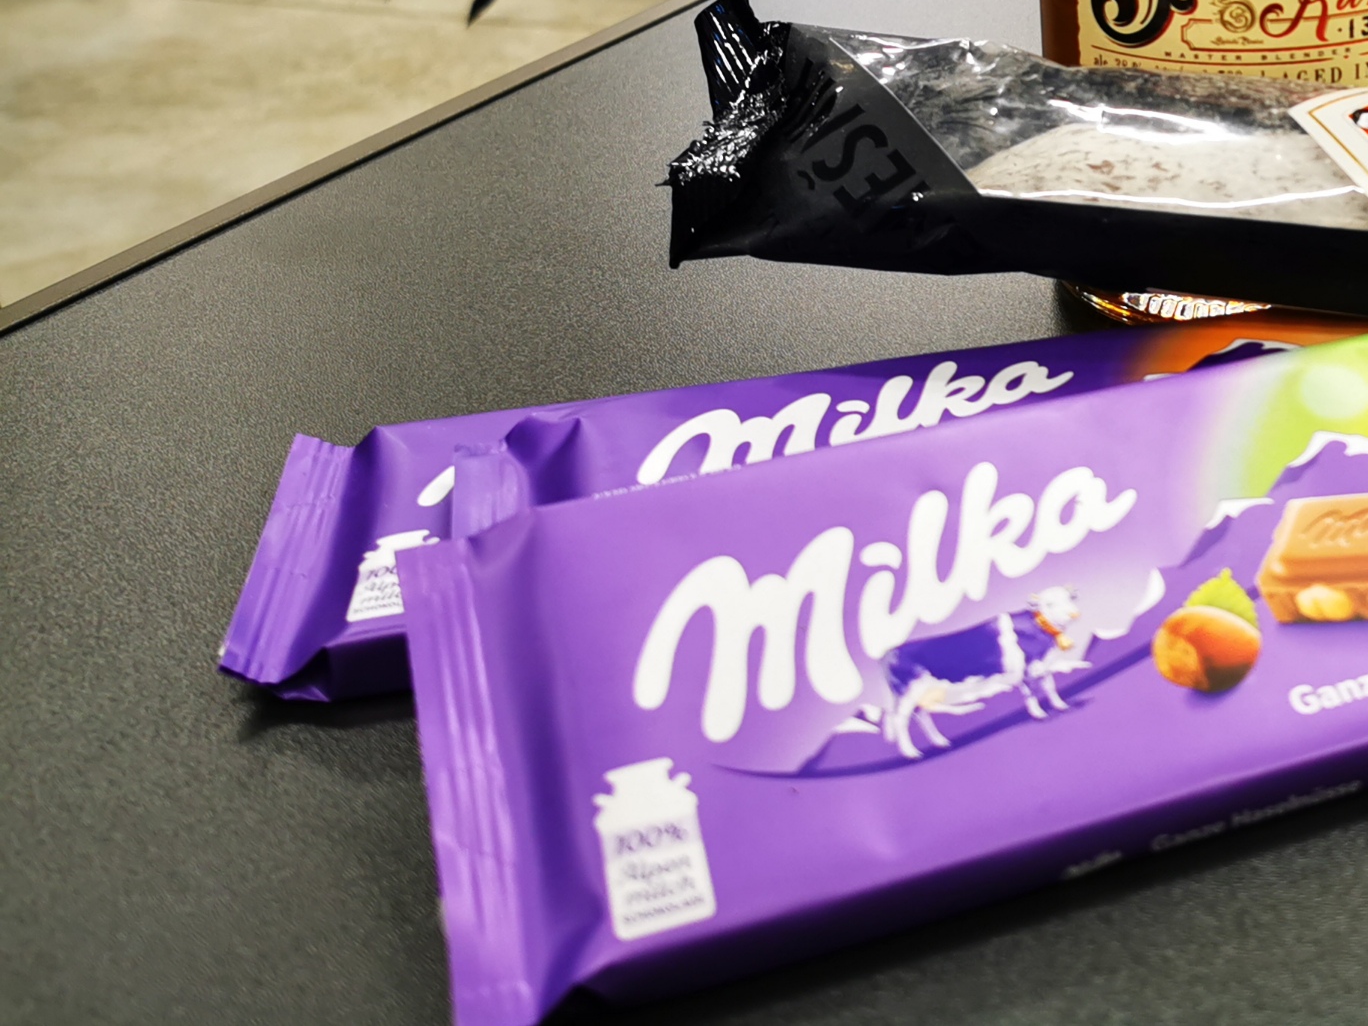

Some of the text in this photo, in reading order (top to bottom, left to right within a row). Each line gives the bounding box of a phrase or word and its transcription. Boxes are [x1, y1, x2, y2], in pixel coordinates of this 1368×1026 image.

[1163, 47, 1352, 62] MASTER BLENDER
[636, 361, 1075, 486] Milka
[632, 461, 1138, 744] Milka
